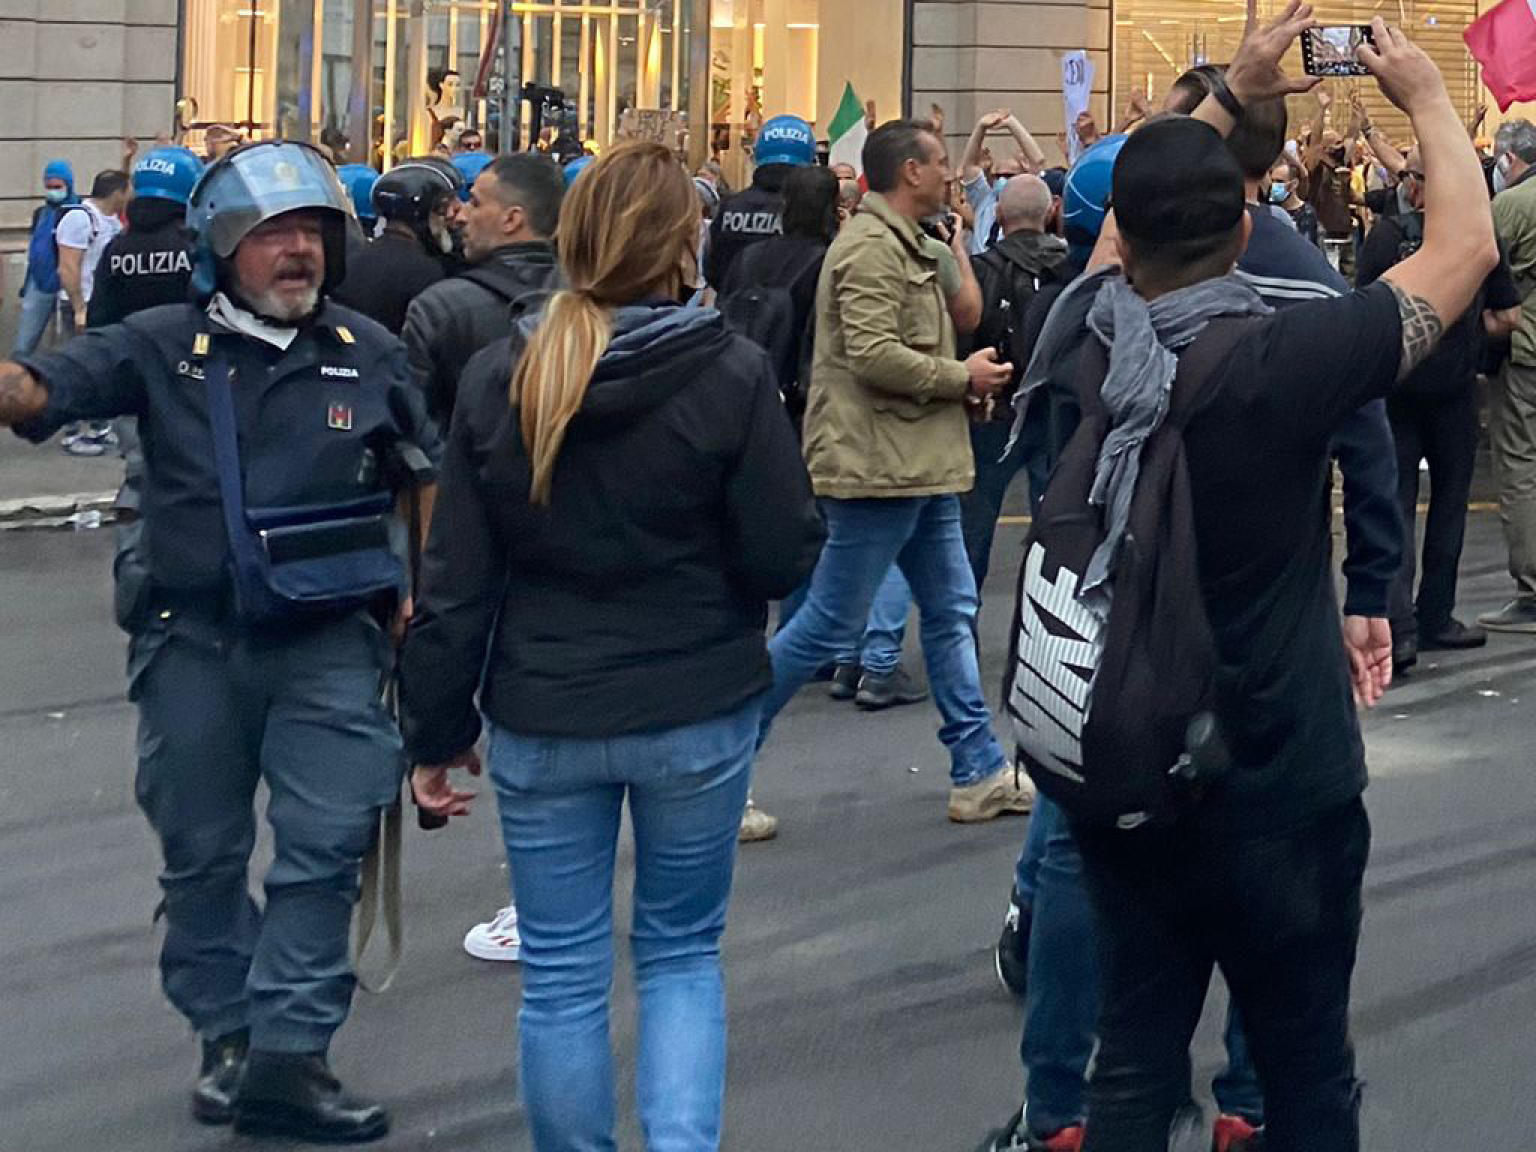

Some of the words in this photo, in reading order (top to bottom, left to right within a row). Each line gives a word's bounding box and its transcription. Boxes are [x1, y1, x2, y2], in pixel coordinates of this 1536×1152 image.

[765, 128, 808, 144] POLIZIA
[722, 211, 783, 235] POLIZIA
[110, 250, 192, 275] POLIZIA
[1009, 541, 1102, 784] NIKE
